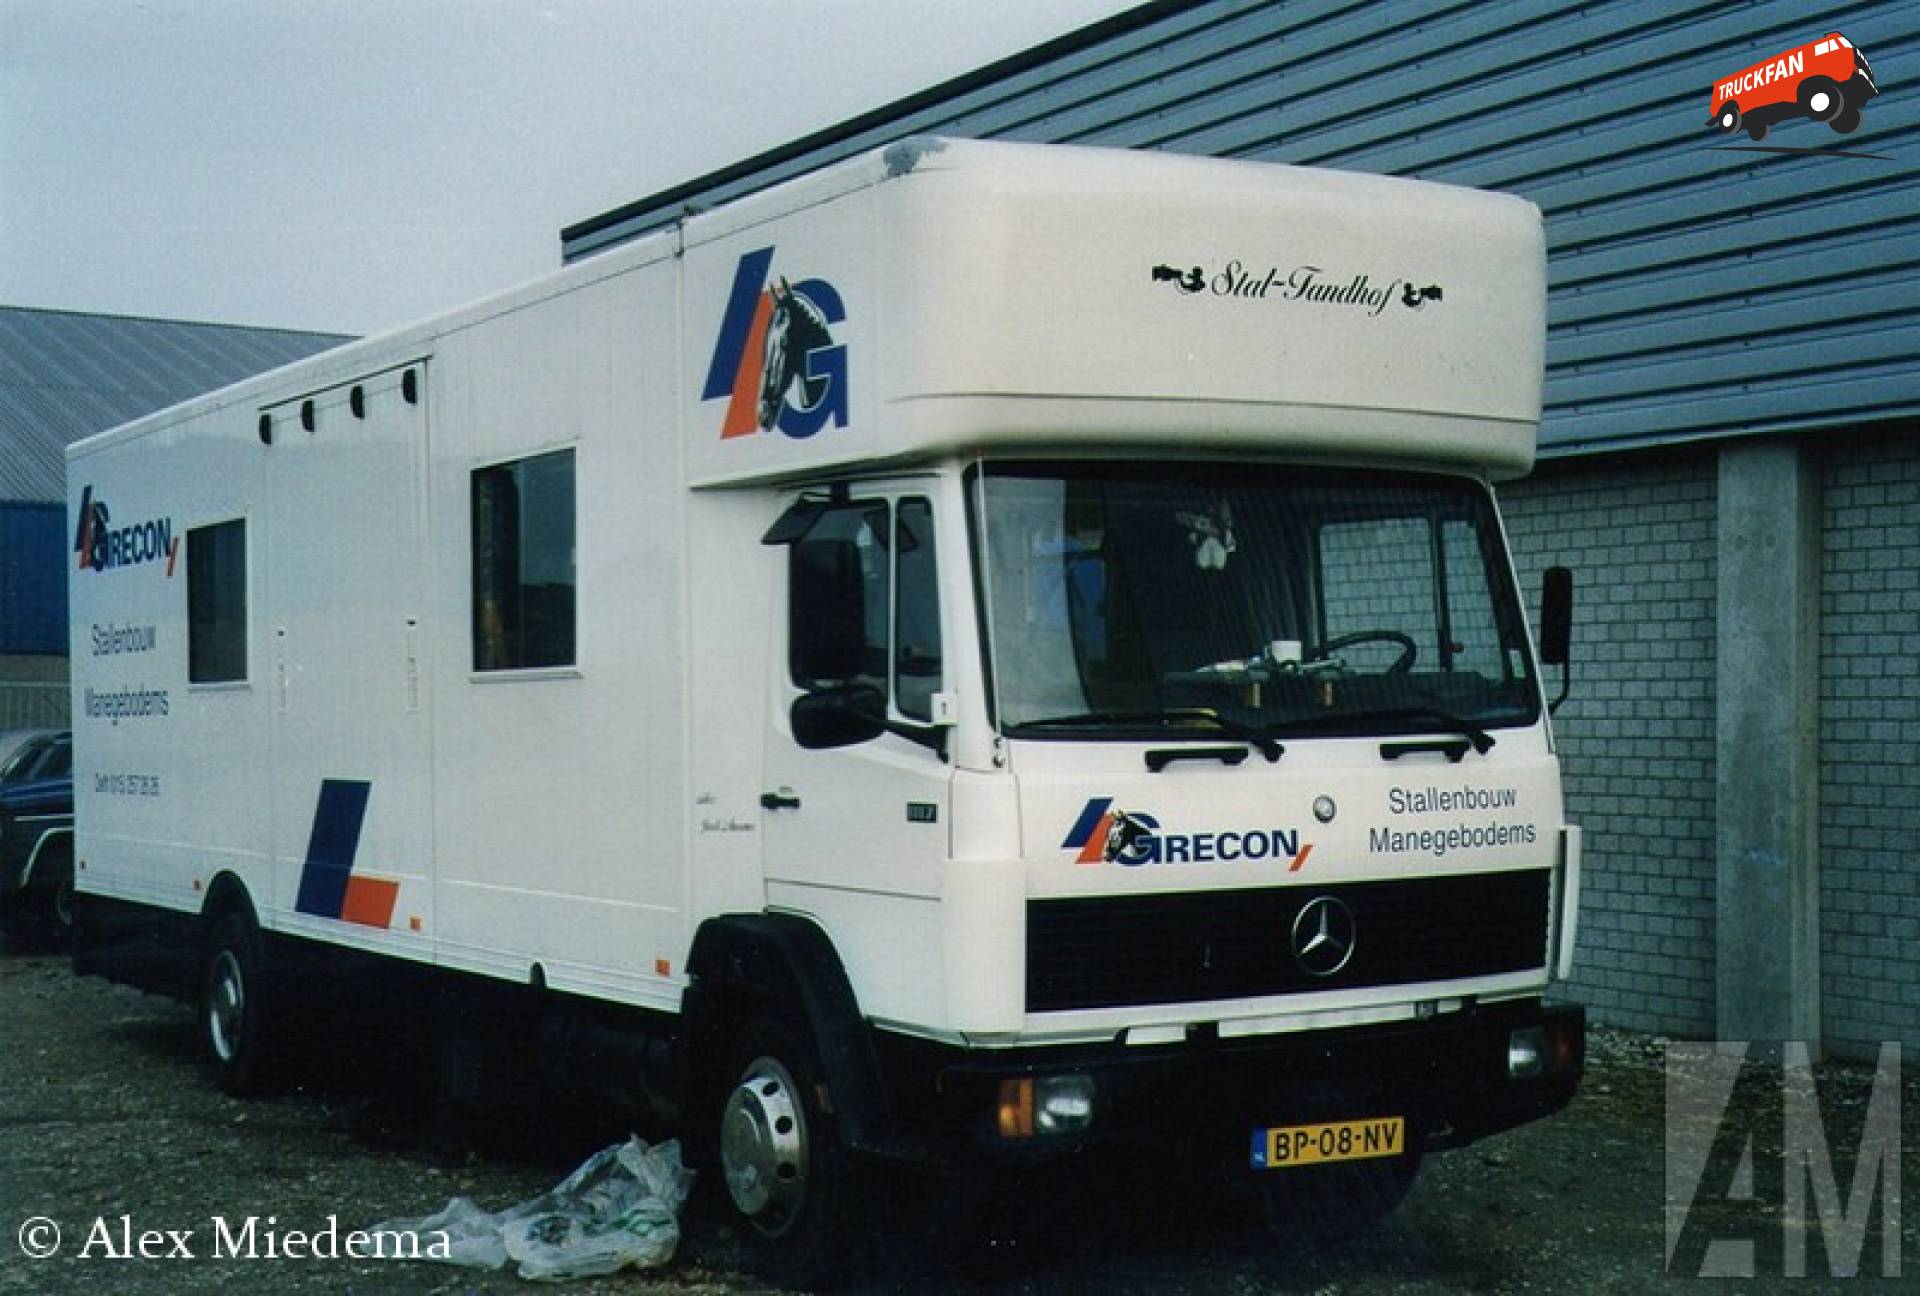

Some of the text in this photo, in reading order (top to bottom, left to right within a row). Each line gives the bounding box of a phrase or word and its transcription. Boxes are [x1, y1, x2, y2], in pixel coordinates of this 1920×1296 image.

[1389, 785, 1517, 816] Stallenbouw
[1114, 812, 1299, 867] GRECON
[1368, 821, 1537, 857] Manegebodems
[1276, 1123, 1398, 1160] BP-08-NV
